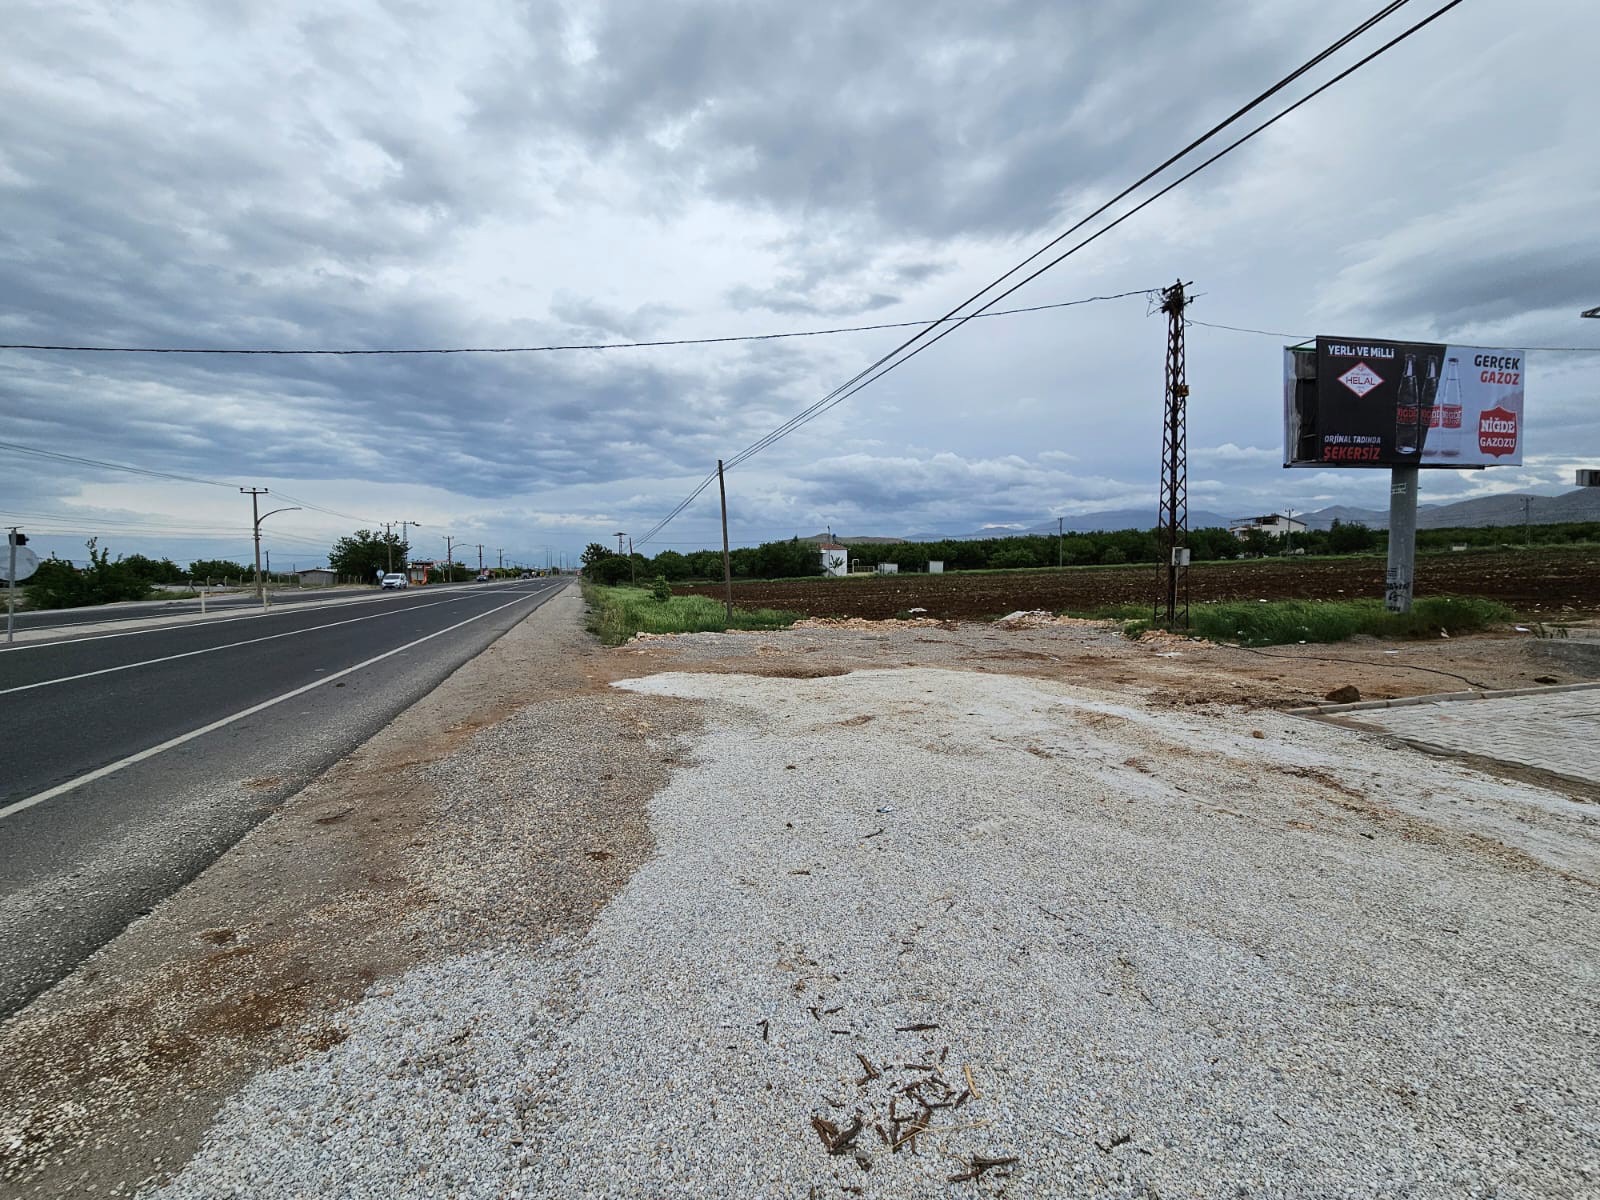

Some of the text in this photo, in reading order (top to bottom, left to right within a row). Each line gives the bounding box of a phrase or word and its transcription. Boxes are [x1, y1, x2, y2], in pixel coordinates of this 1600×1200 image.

[1357, 347, 1369, 357] VE
[1474, 354, 1520, 371] GERÇEK
[1346, 376, 1376, 385] HELAL
[1480, 370, 1520, 385] GAZOZ
[1481, 417, 1515, 433] NİĞDE
[1480, 437, 1515, 448] GAZOZU
[1323, 445, 1381, 461] ŞEKERSİZ
